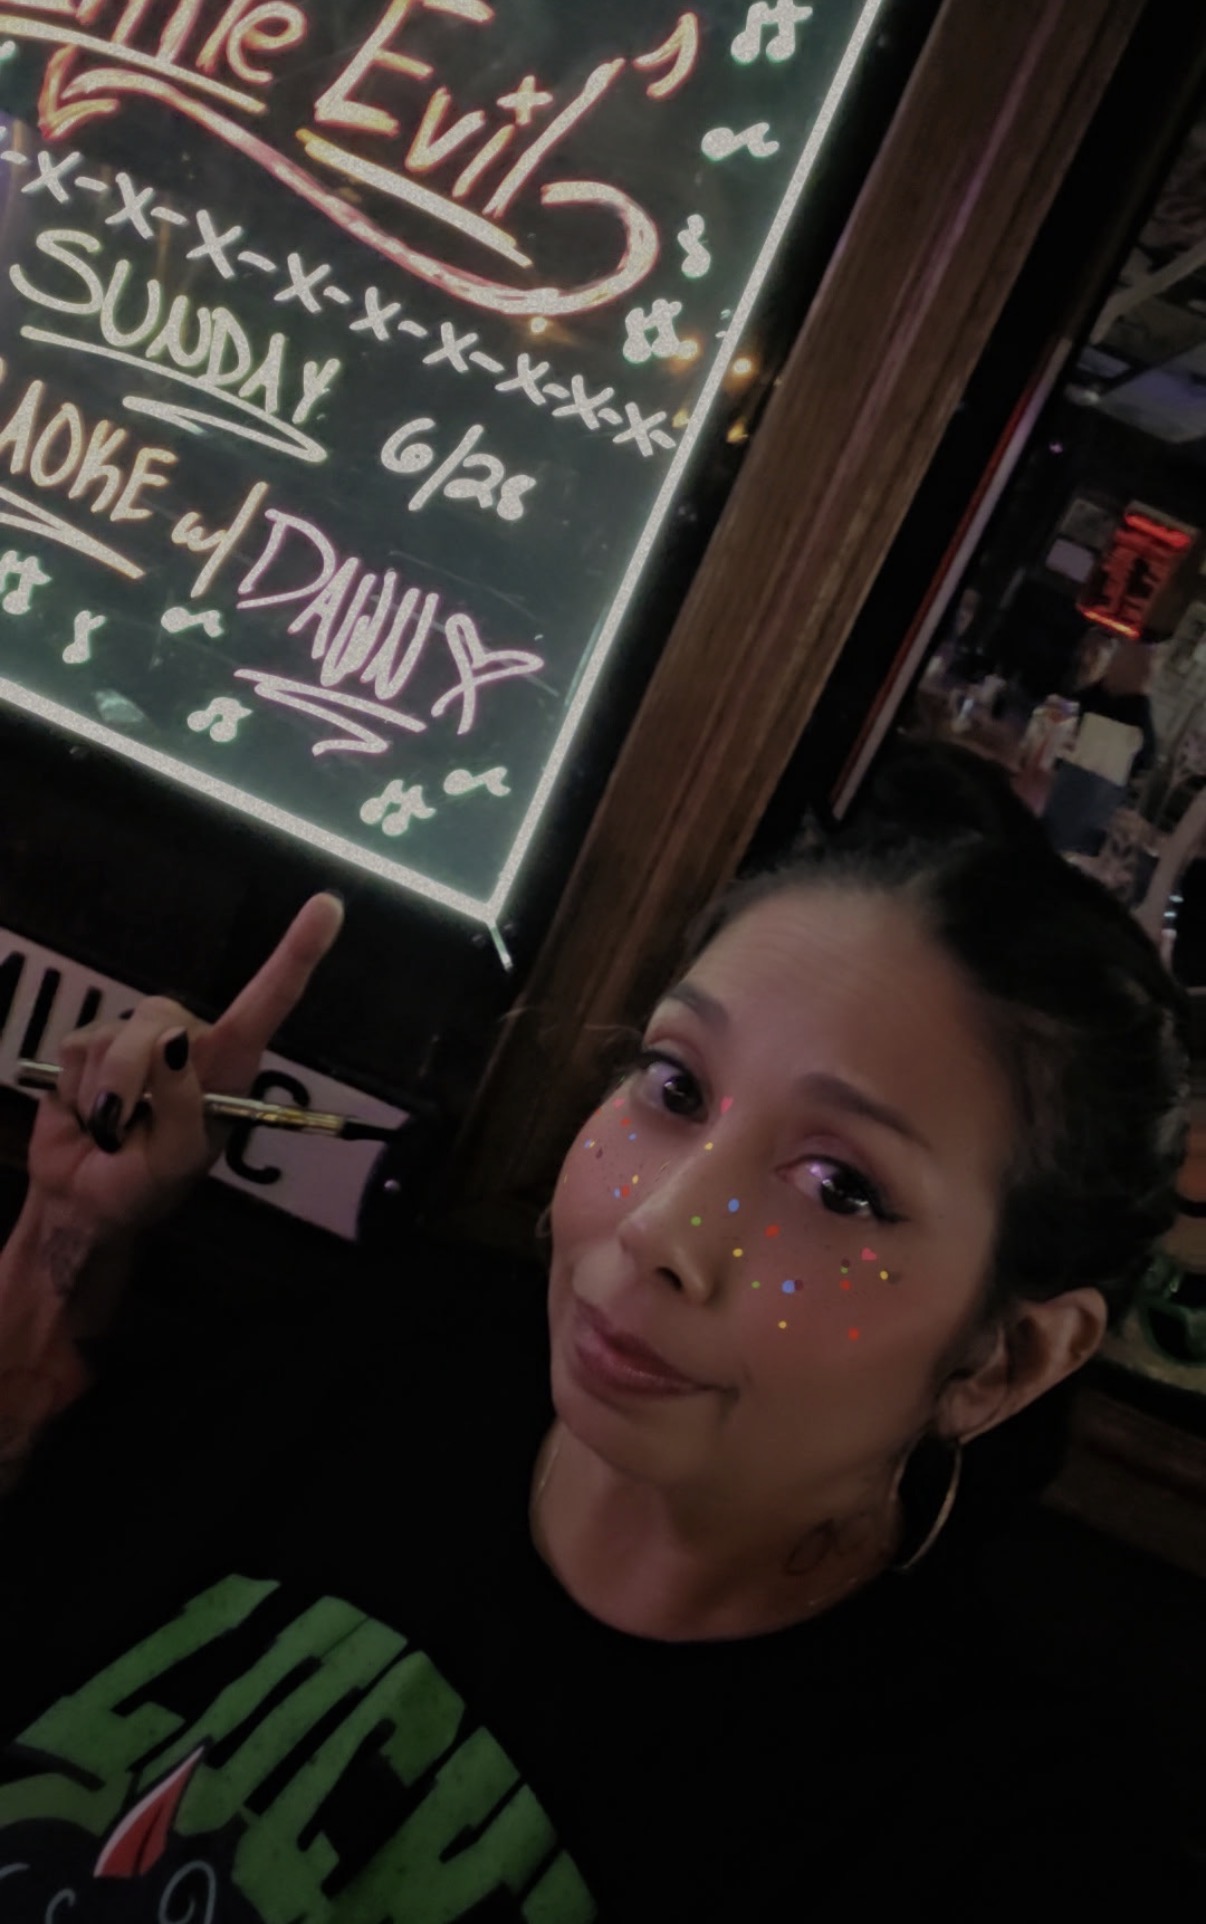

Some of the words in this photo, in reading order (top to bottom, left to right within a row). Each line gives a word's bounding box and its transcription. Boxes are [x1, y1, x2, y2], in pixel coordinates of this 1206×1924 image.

[314, 0, 626, 217] Evil
[0, 365, 178, 523] AOKE
[9, 229, 341, 424] SUNDAY
[380, 417, 536, 520] 6/28
